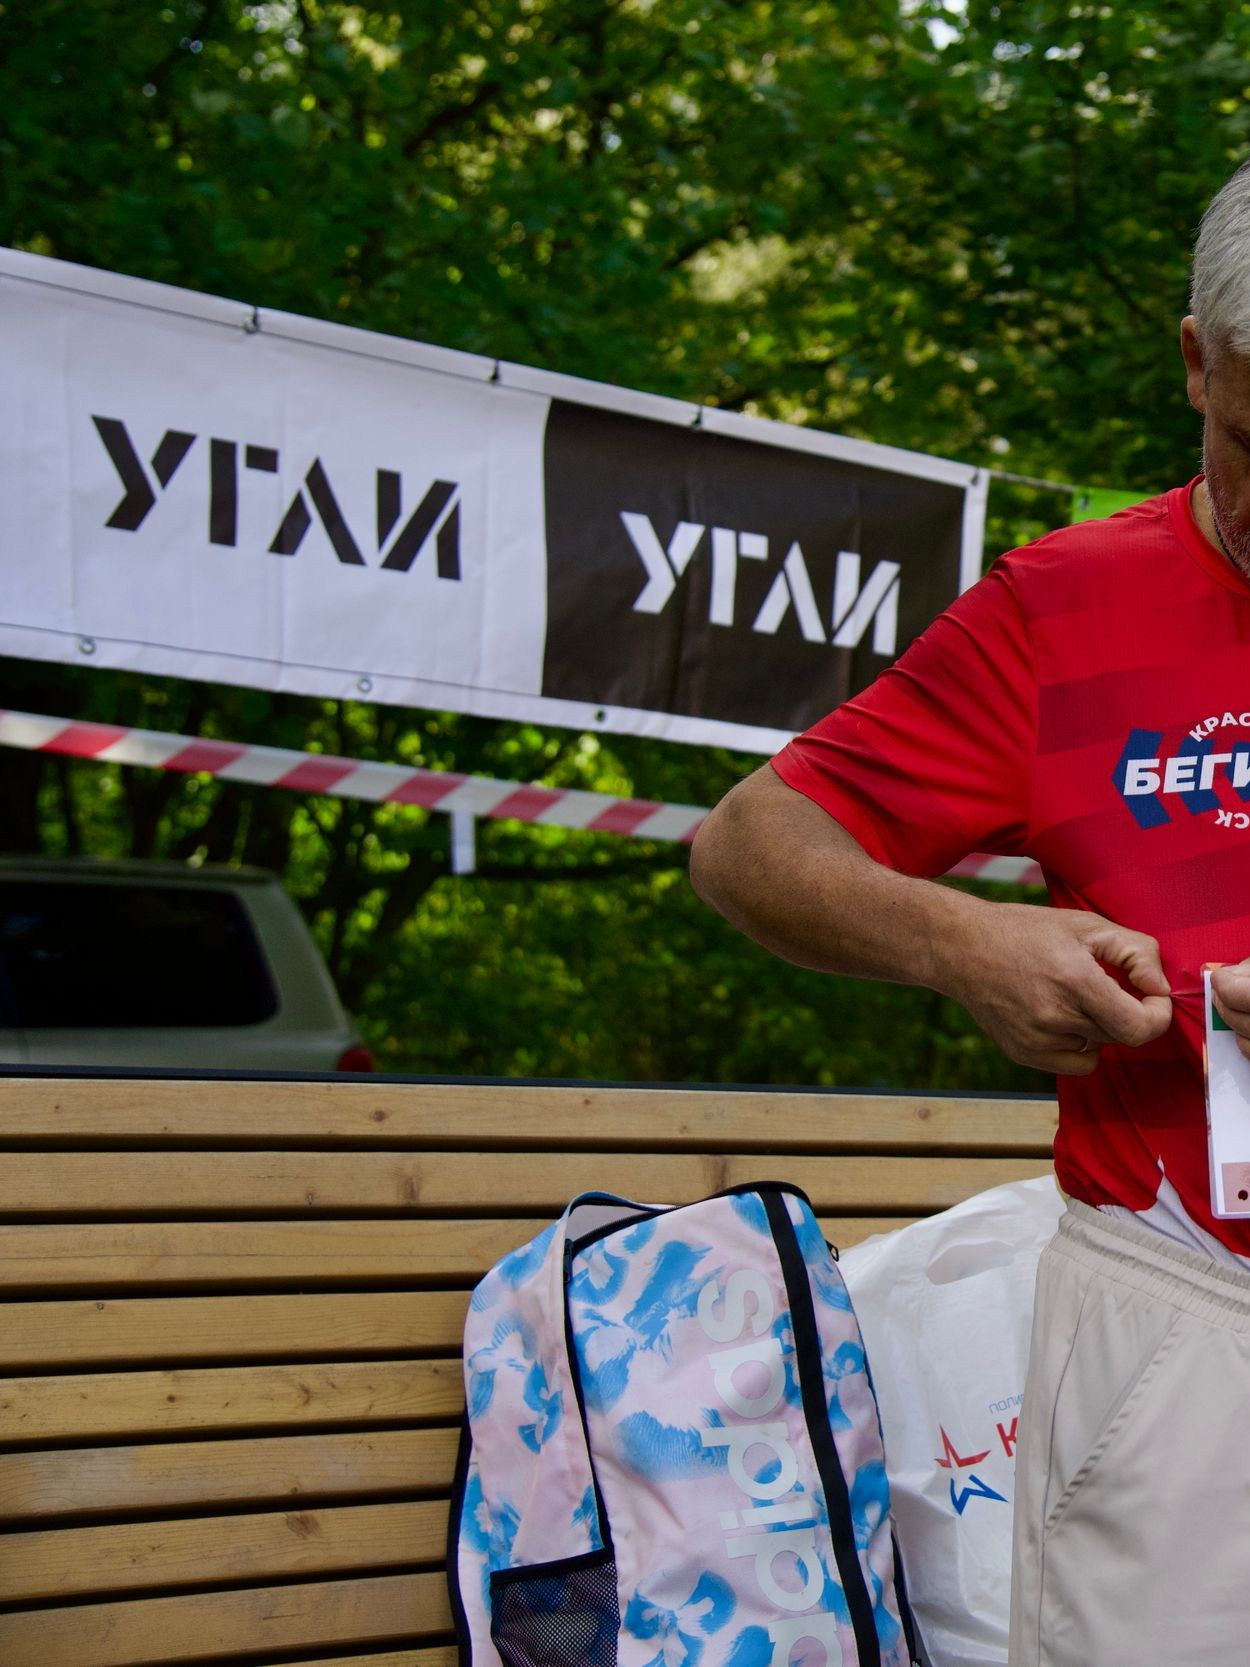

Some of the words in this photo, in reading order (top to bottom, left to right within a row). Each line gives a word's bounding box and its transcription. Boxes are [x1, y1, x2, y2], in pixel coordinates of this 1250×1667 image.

[91, 414, 463, 581] УГЛИ
[620, 510, 901, 656] УГЛИ
[698, 1269, 843, 1667] adidas
